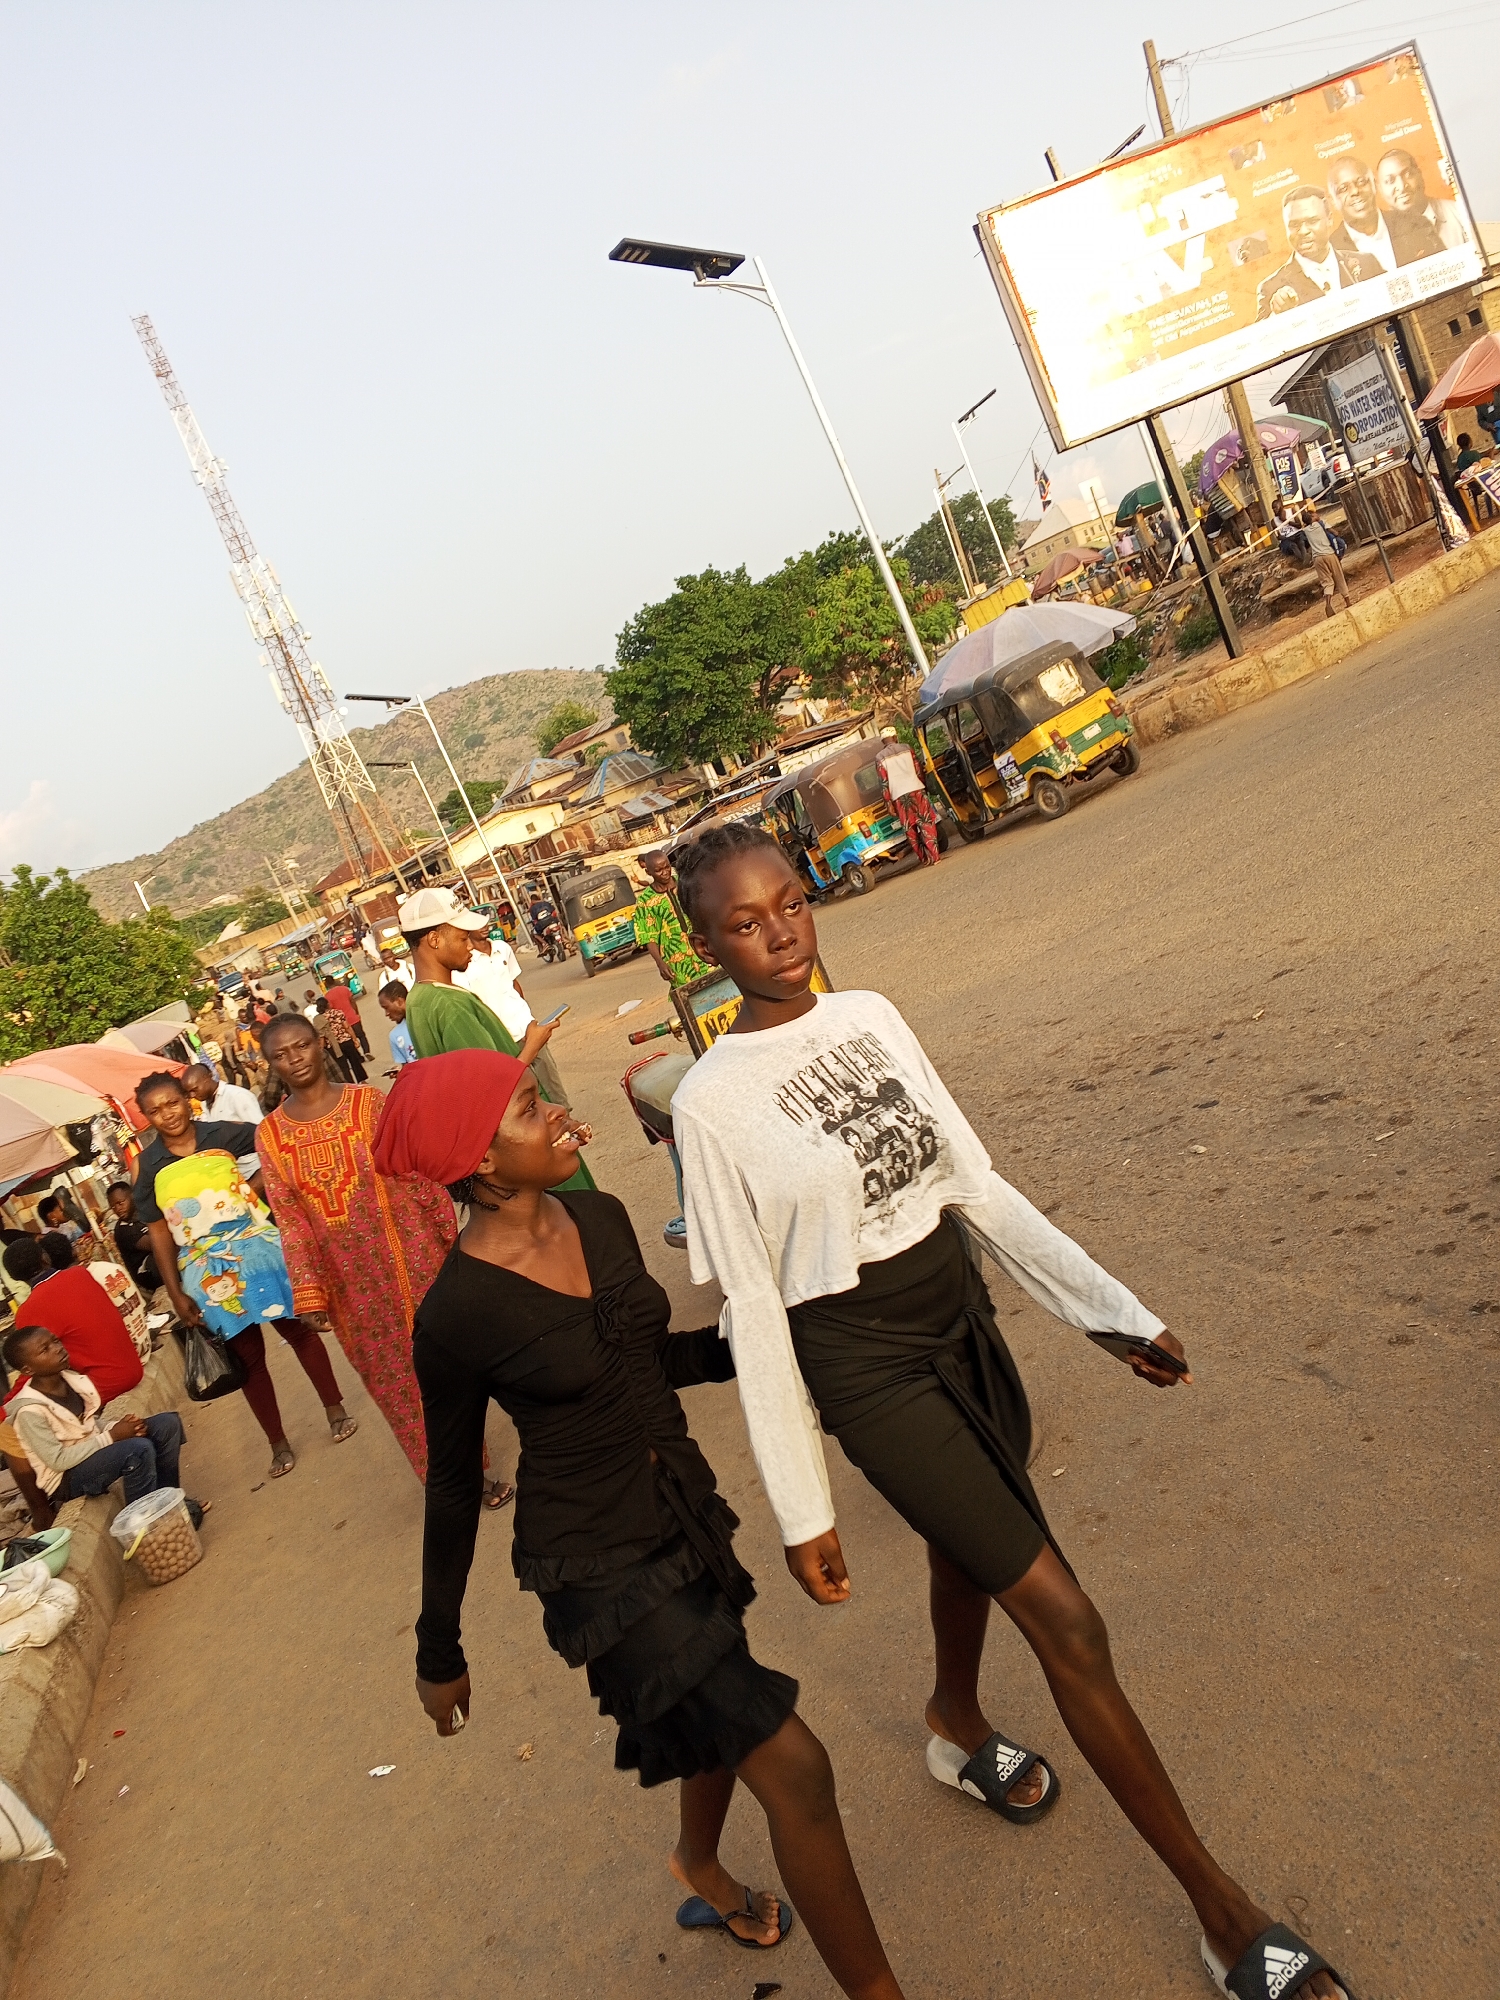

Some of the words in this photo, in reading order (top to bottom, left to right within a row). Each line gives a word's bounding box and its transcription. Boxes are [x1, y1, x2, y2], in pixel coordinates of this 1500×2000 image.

[1336, 405, 1352, 423] JOS
[1349, 393, 1372, 417] WATER
[1352, 404, 1400, 434] ORPORATION
[1381, 421, 1400, 434] STATE
[1275, 457, 1291, 470] POS
[999, 1750, 1026, 1782] adidas
[1268, 1951, 1310, 2000] adidas
